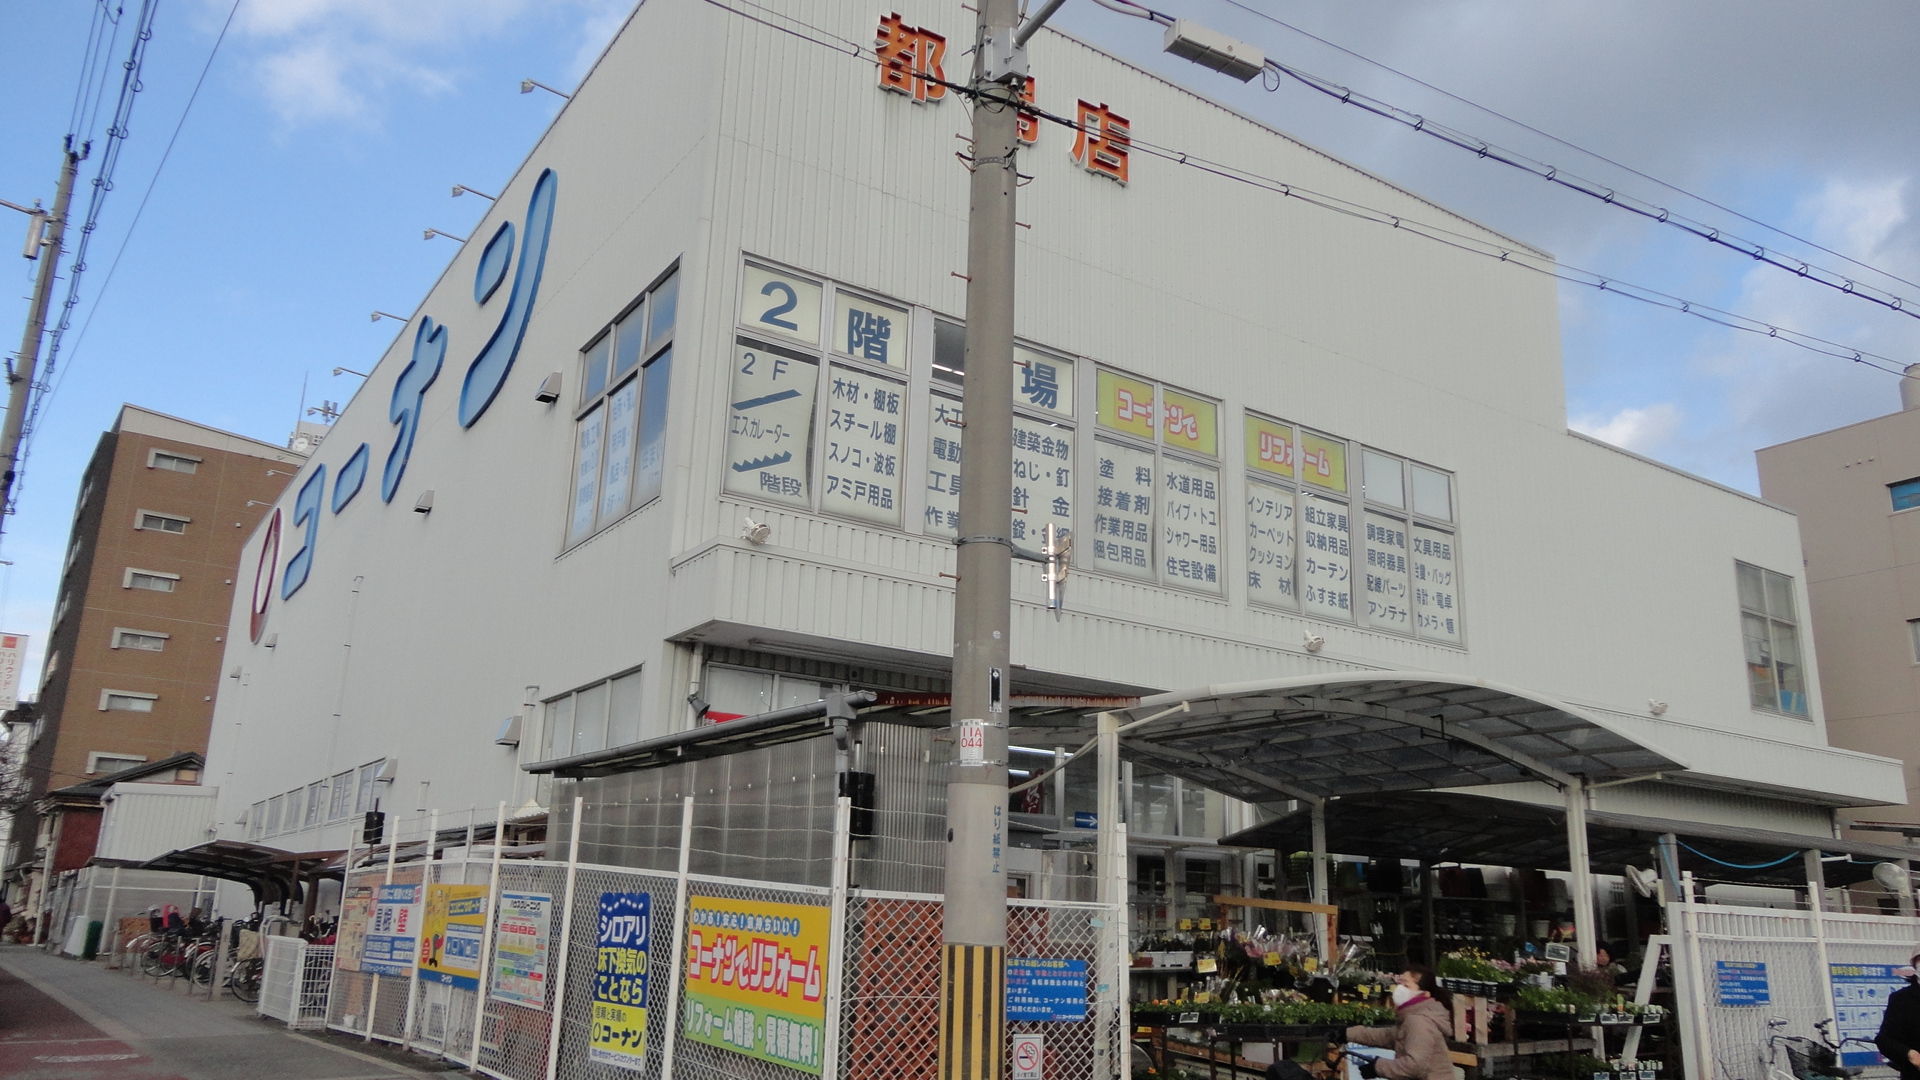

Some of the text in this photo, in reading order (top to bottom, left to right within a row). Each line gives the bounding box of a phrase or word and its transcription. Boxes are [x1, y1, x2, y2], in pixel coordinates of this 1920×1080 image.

[832, 378, 899, 416] 木材・棚板
[829, 409, 897, 446] スチール棚
[1117, 387, 1198, 441] コーナンで
[731, 415, 791, 444] エスカレーター
[1013, 428, 1069, 461] 建築金物
[1259, 430, 1331, 477] リフォーム
[828, 442, 896, 478] スノコ・波板
[1013, 458, 1070, 488] ねじ・釘
[759, 471, 803, 498] 階段
[826, 475, 893, 510] アミ戸用品
[1166, 471, 1215, 500] 水道用品
[1097, 485, 1150, 515] 接着剤
[1247, 495, 1292, 521] インテリア
[1094, 513, 1148, 543] 作業用品
[1305, 505, 1348, 533] 組立家具
[1166, 527, 1216, 555] シャワー用品
[1249, 521, 1294, 547] カーペット
[1305, 530, 1349, 557] 収納用品
[1366, 522, 1405, 550] 調理家電
[1249, 546, 1294, 571] クッション
[1367, 549, 1406, 574] 照明器具
[1413, 537, 1452, 561] 文具用品
[1166, 556, 1216, 583] 住宅設備
[1306, 557, 1349, 582] カーテン
[1305, 584, 1349, 611] ふすま紙
[1367, 601, 1407, 624] アンテナ
[961, 738, 983, 748] 044
[992, 804, 1002, 874] はり紙禁止
[600, 915, 647, 945] シロアリ
[597, 946, 647, 975] 床下換気の
[689, 929, 821, 1002] コーナンでリフォーム
[598, 976, 643, 1005] ことなら
